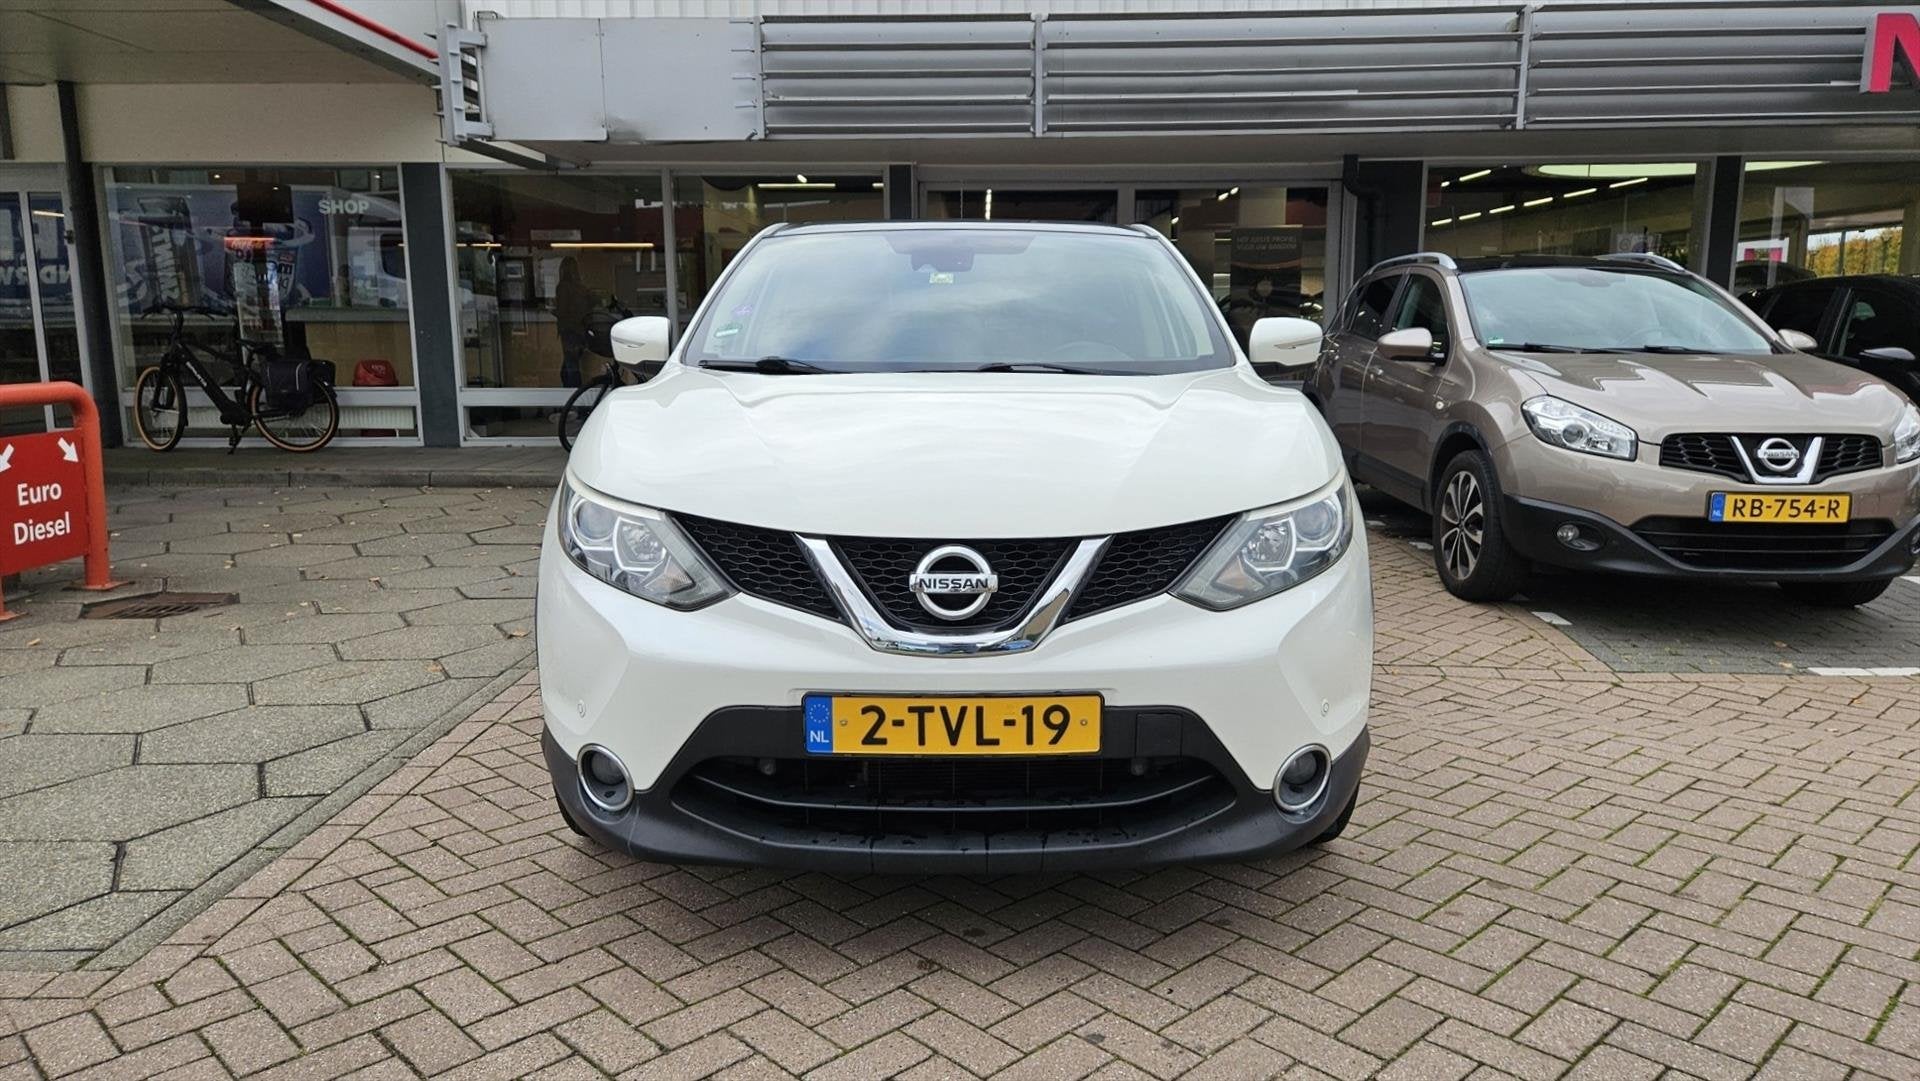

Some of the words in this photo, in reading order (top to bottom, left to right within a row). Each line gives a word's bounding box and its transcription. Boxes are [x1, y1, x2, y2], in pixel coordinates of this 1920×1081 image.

[318, 199, 370, 215] SHOP
[17, 482, 62, 506] Euro
[1732, 498, 1840, 518] RB-754-R
[13, 511, 71, 545] Diesel
[918, 576, 989, 590] NISSAN
[860, 704, 1071, 746] 2-TVL-19
[809, 730, 830, 744] NL
